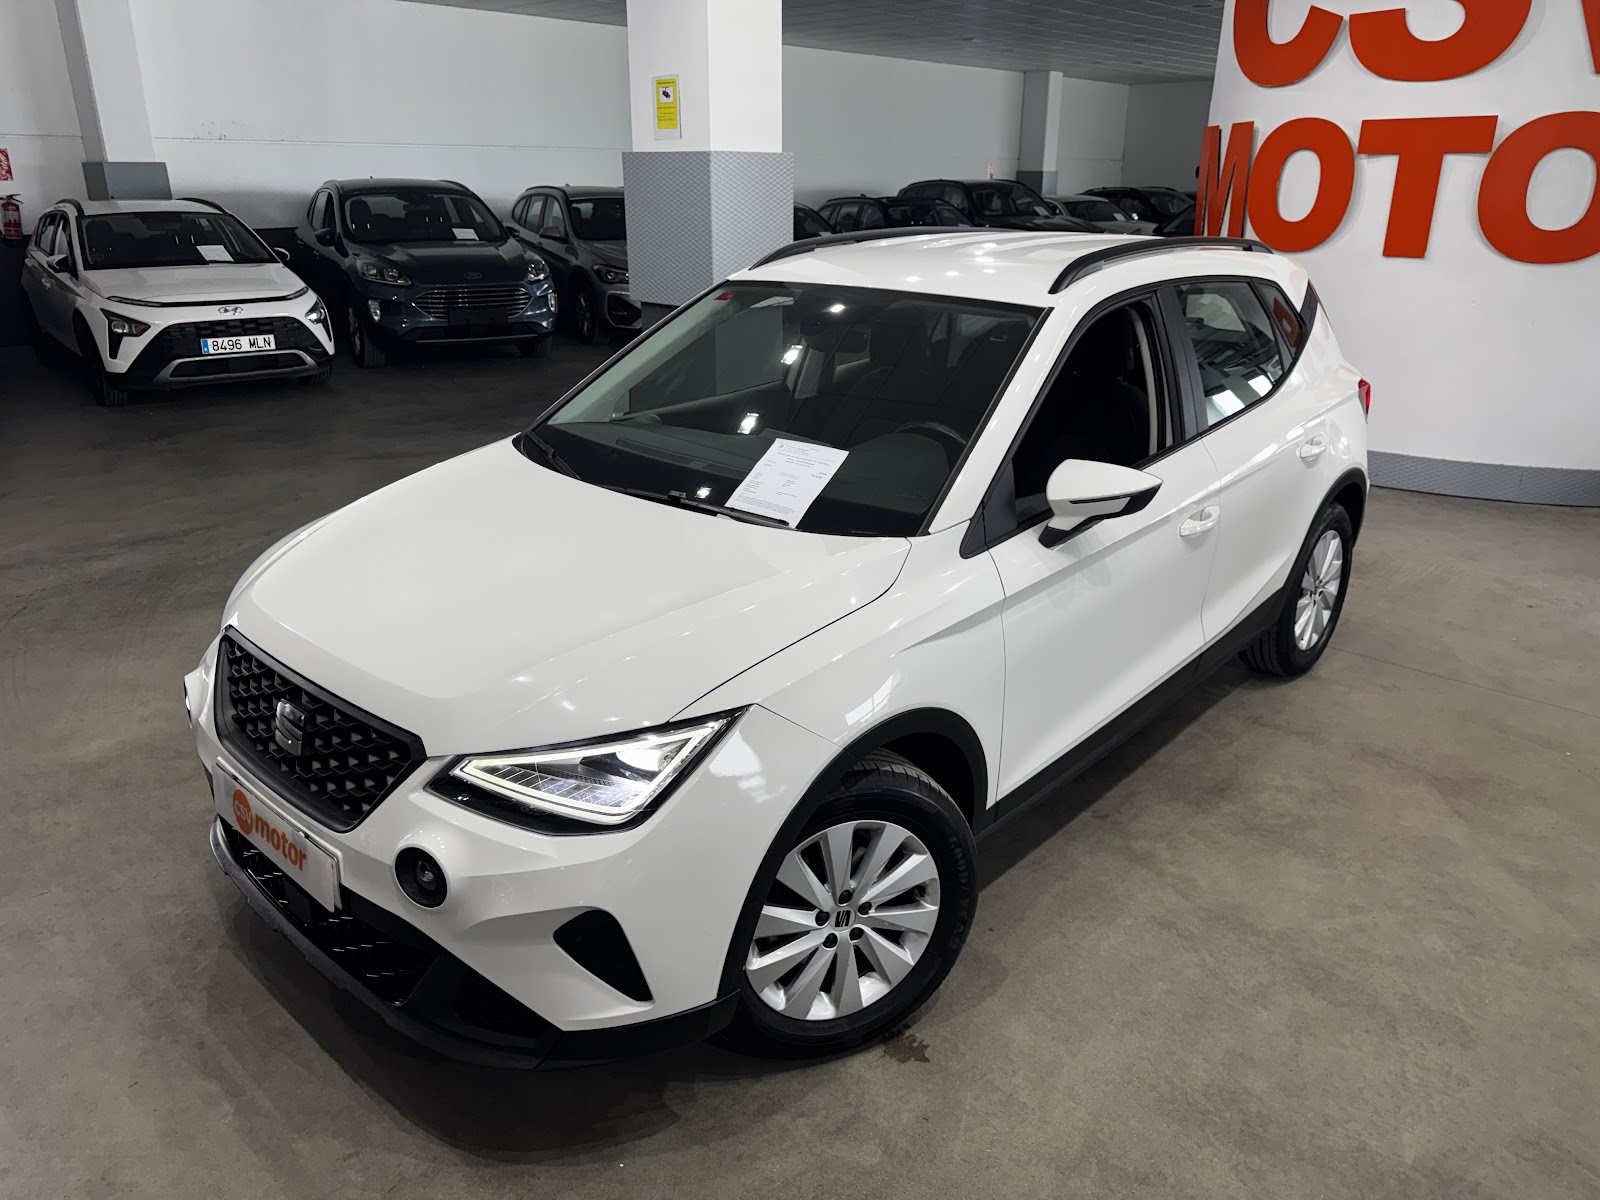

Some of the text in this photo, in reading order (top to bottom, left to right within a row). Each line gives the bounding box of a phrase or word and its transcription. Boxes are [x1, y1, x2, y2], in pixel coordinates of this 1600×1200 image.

[211, 337, 271, 351] 8496 MLN
[255, 813, 307, 872] motor
